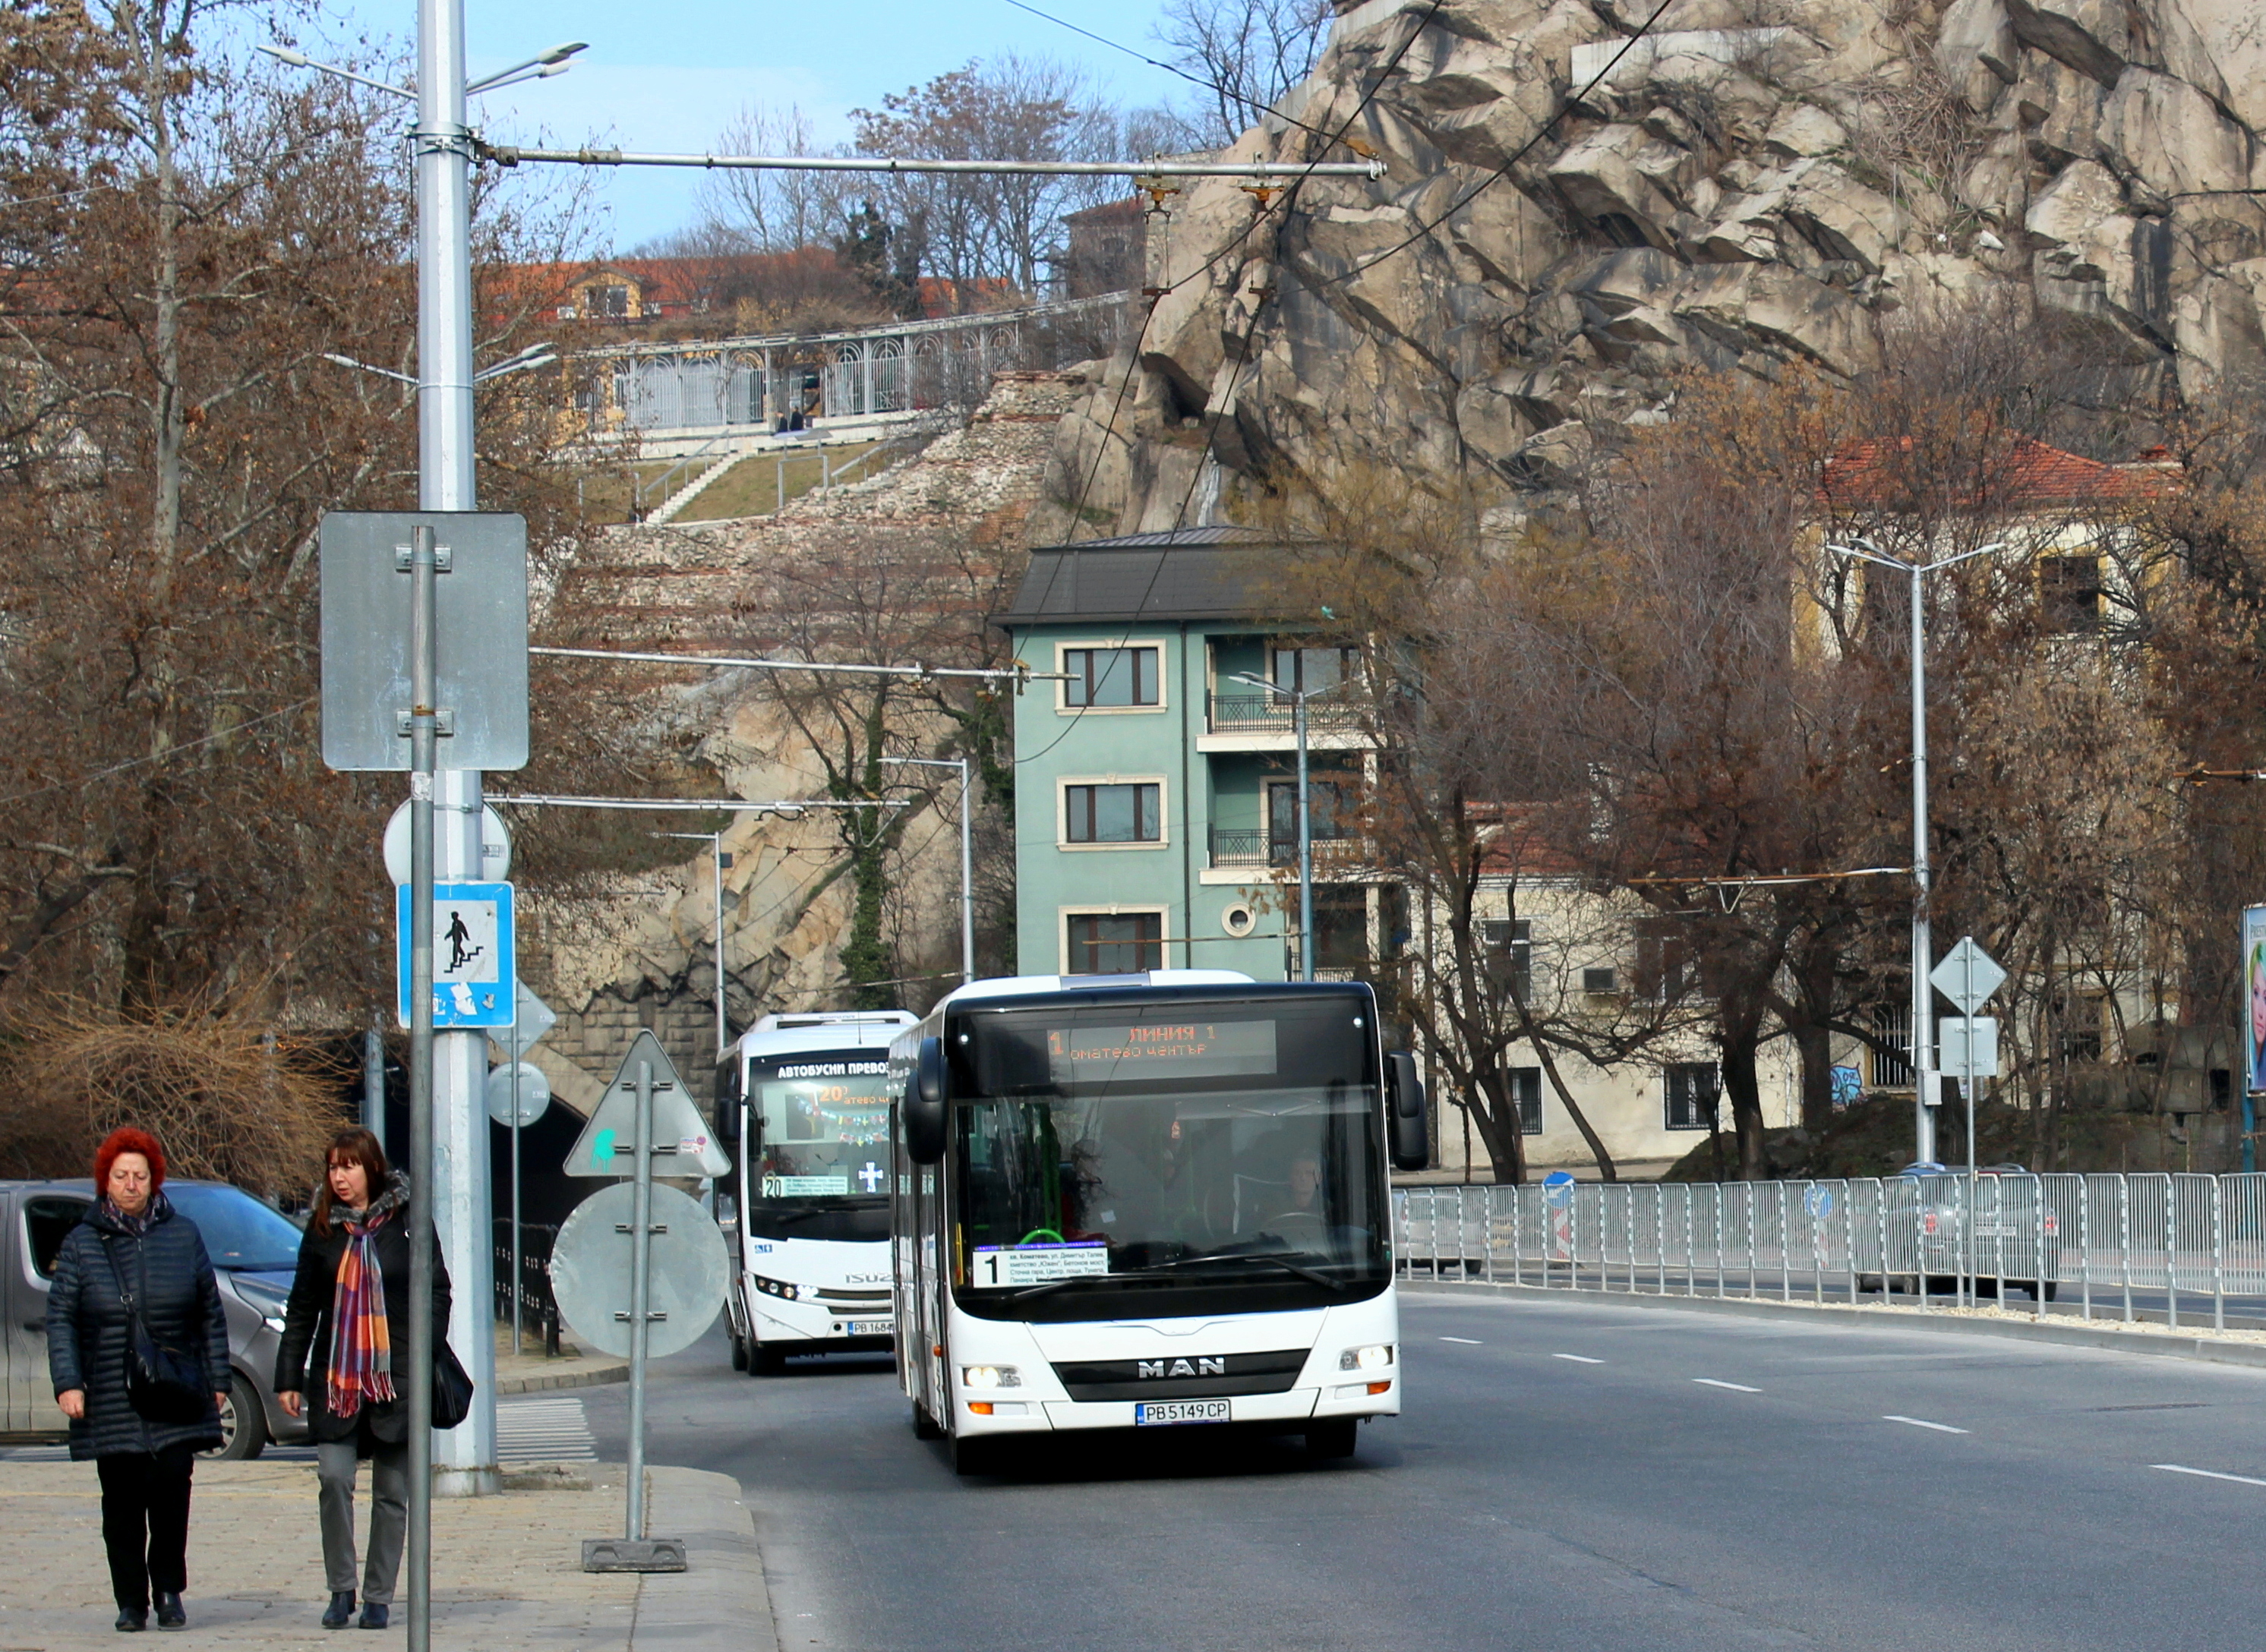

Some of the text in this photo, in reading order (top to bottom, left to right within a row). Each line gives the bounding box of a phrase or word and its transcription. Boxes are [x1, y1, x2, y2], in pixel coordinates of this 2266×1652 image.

[1130, 1026, 1216, 1042] ЛИНИЯ 1
[1049, 1032, 1063, 1055] 1
[778, 1064, 845, 1079] АВТОБУСНИ
[819, 1086, 843, 1102] 20
[766, 1179, 781, 1197] 20
[845, 1272, 892, 1283] ISUZ
[984, 1255, 998, 1284] 1
[1138, 1357, 1225, 1379] MAN
[1169, 1404, 1204, 1419] 5149
